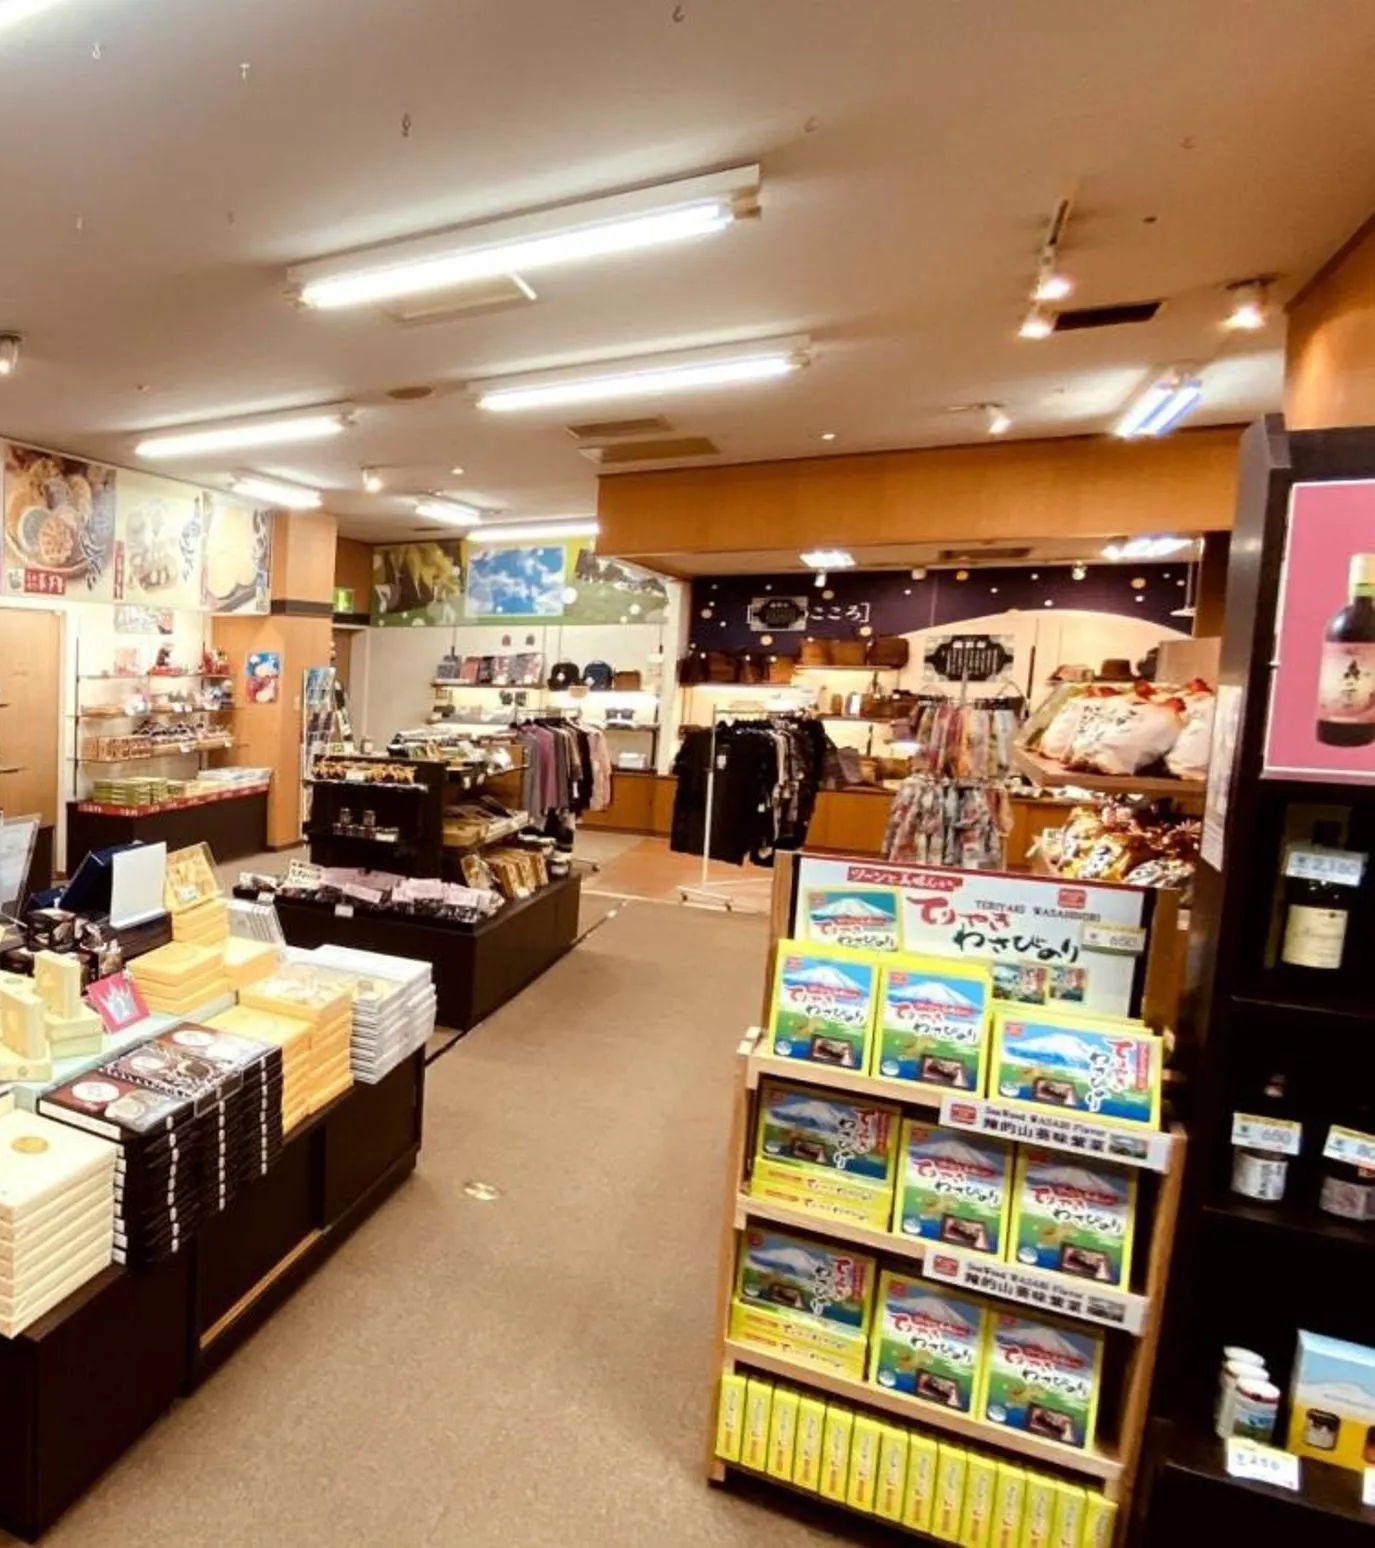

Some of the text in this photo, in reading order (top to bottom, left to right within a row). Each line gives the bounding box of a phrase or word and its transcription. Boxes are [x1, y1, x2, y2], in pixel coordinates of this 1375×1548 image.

[906, 896, 1010, 932] てりやき
[952, 923, 1079, 963] わさびのり
